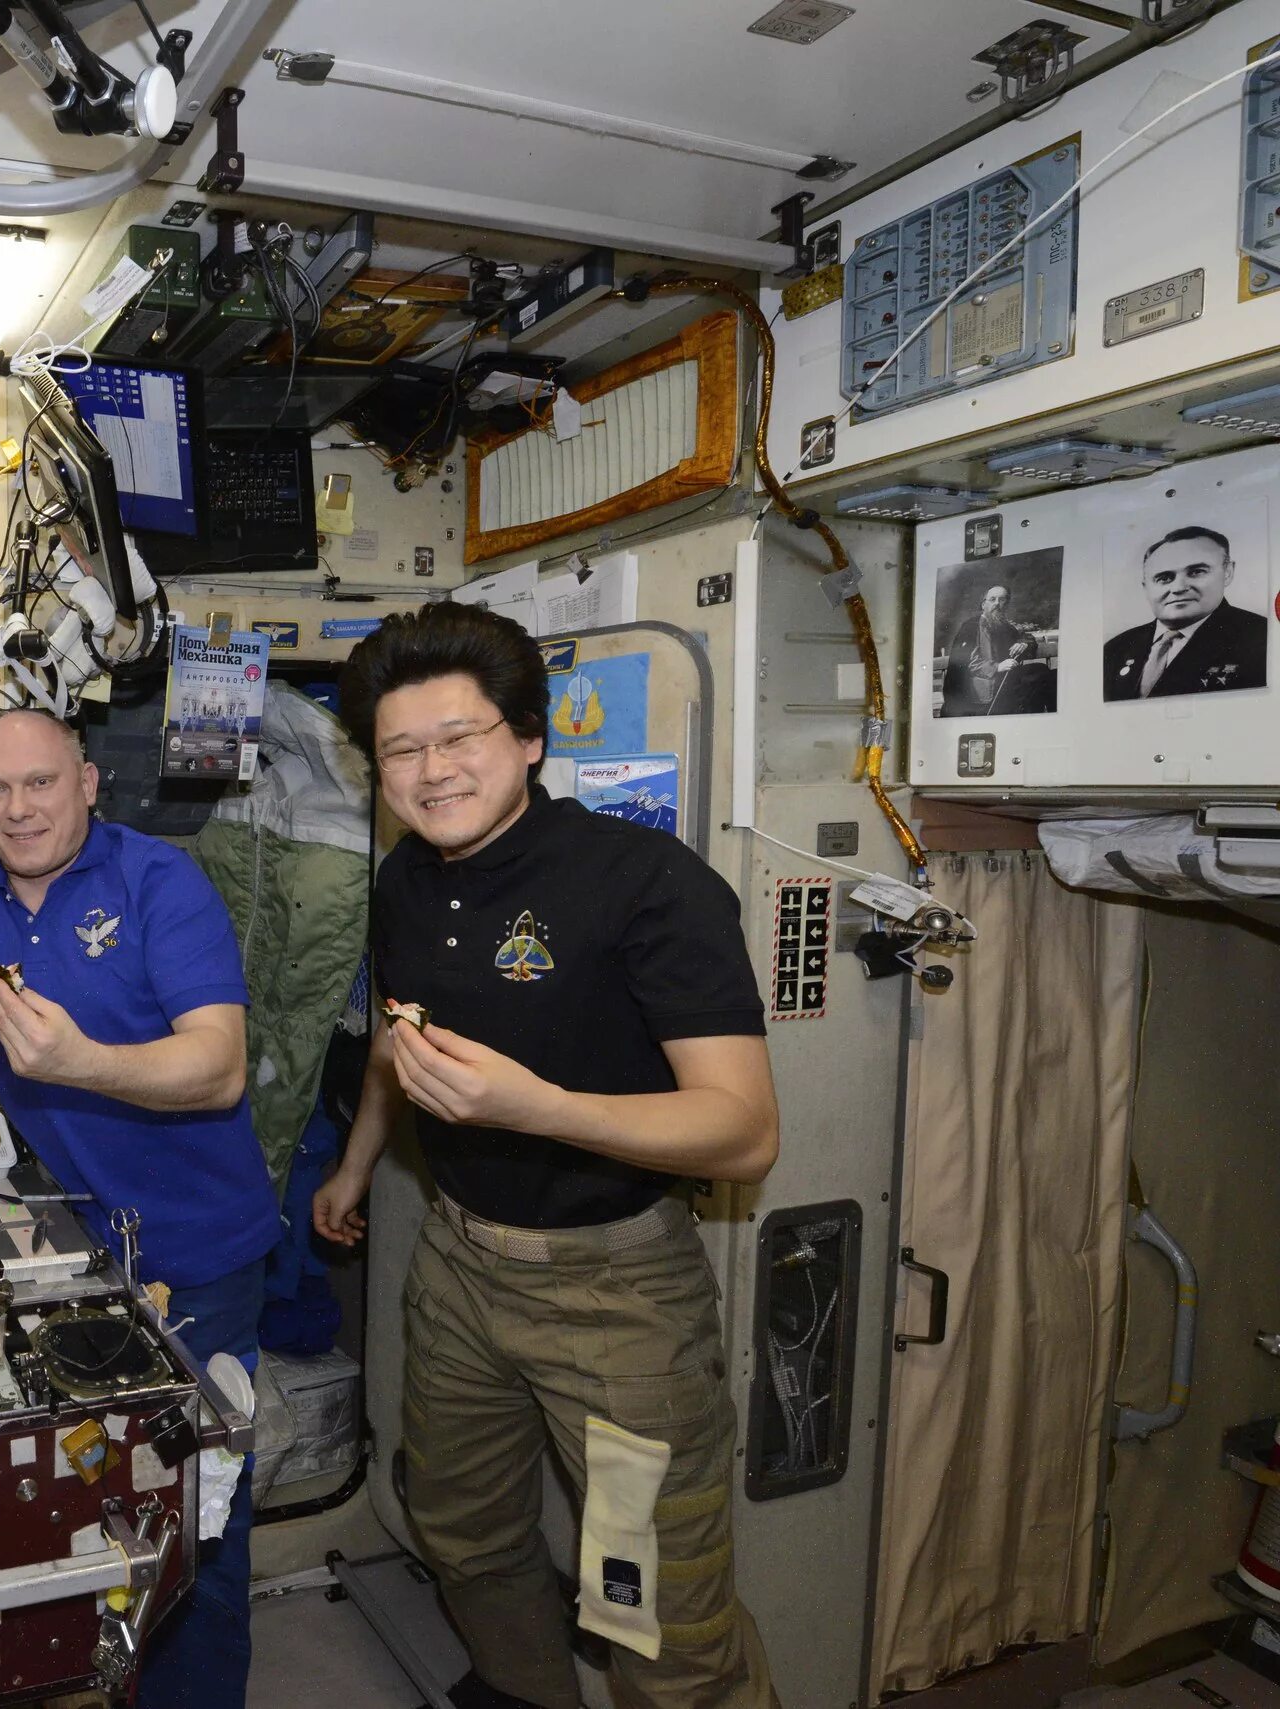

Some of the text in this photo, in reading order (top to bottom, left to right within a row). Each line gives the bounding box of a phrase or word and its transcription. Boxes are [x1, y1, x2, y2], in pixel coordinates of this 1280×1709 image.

[1140, 282, 1176, 306] 338
[178, 636, 260, 655] Попурная
[177, 650, 242, 666] Механика
[185, 674, 246, 685] АНТИРОБОТ
[104, 938, 117, 946] 56
[612, 1595, 633, 1604] СПП-1
